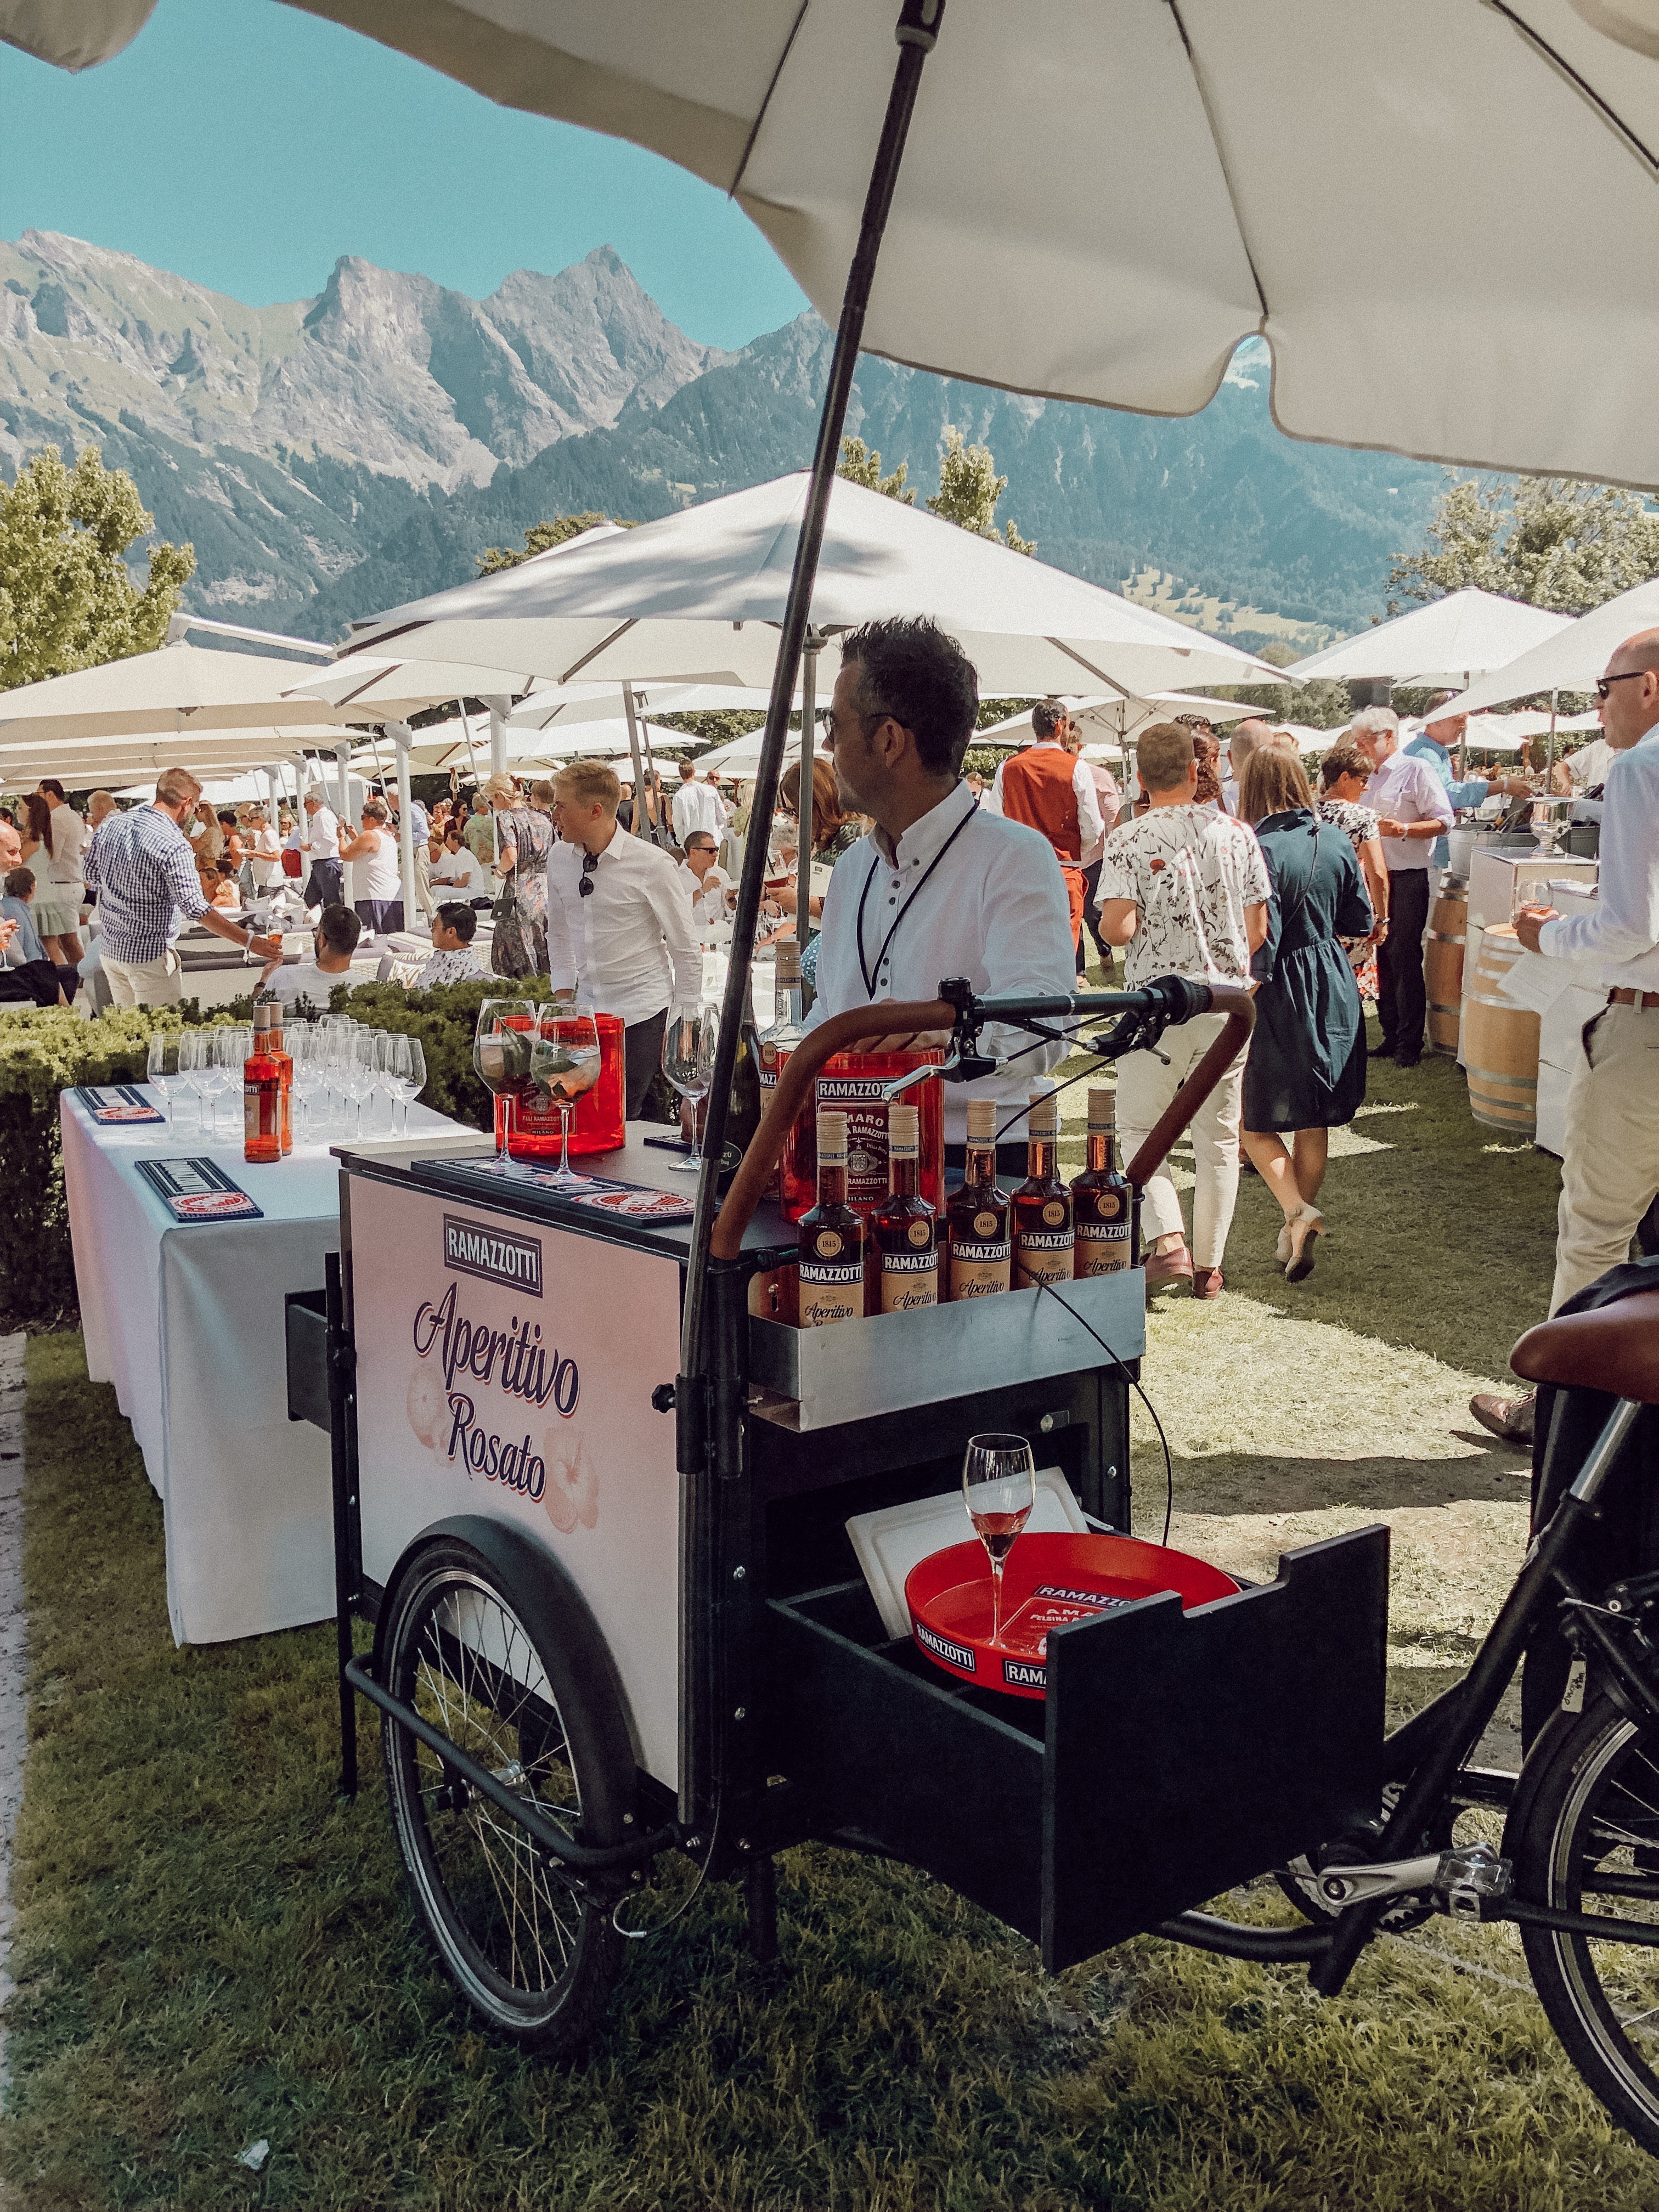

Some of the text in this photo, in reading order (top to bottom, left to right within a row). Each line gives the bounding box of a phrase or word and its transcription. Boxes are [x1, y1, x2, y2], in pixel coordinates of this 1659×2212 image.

[847, 1114, 884, 1127] MARO
[448, 1227, 537, 1283] RAMAZZOTTI
[799, 1265, 862, 1282] RAMAZZOTTI
[1084, 1257, 1126, 1276] Aperitivo
[959, 1278, 1005, 1297] Aperitivo
[893, 1290, 936, 1310] Aperitivo
[804, 1302, 854, 1322] Aperitivo
[413, 1282, 580, 1416] Aperitivo
[448, 1392, 546, 1503] Rosato
[917, 1623, 973, 1667] RAMAZZOTTI
[1008, 1664, 1047, 1685] RAM
